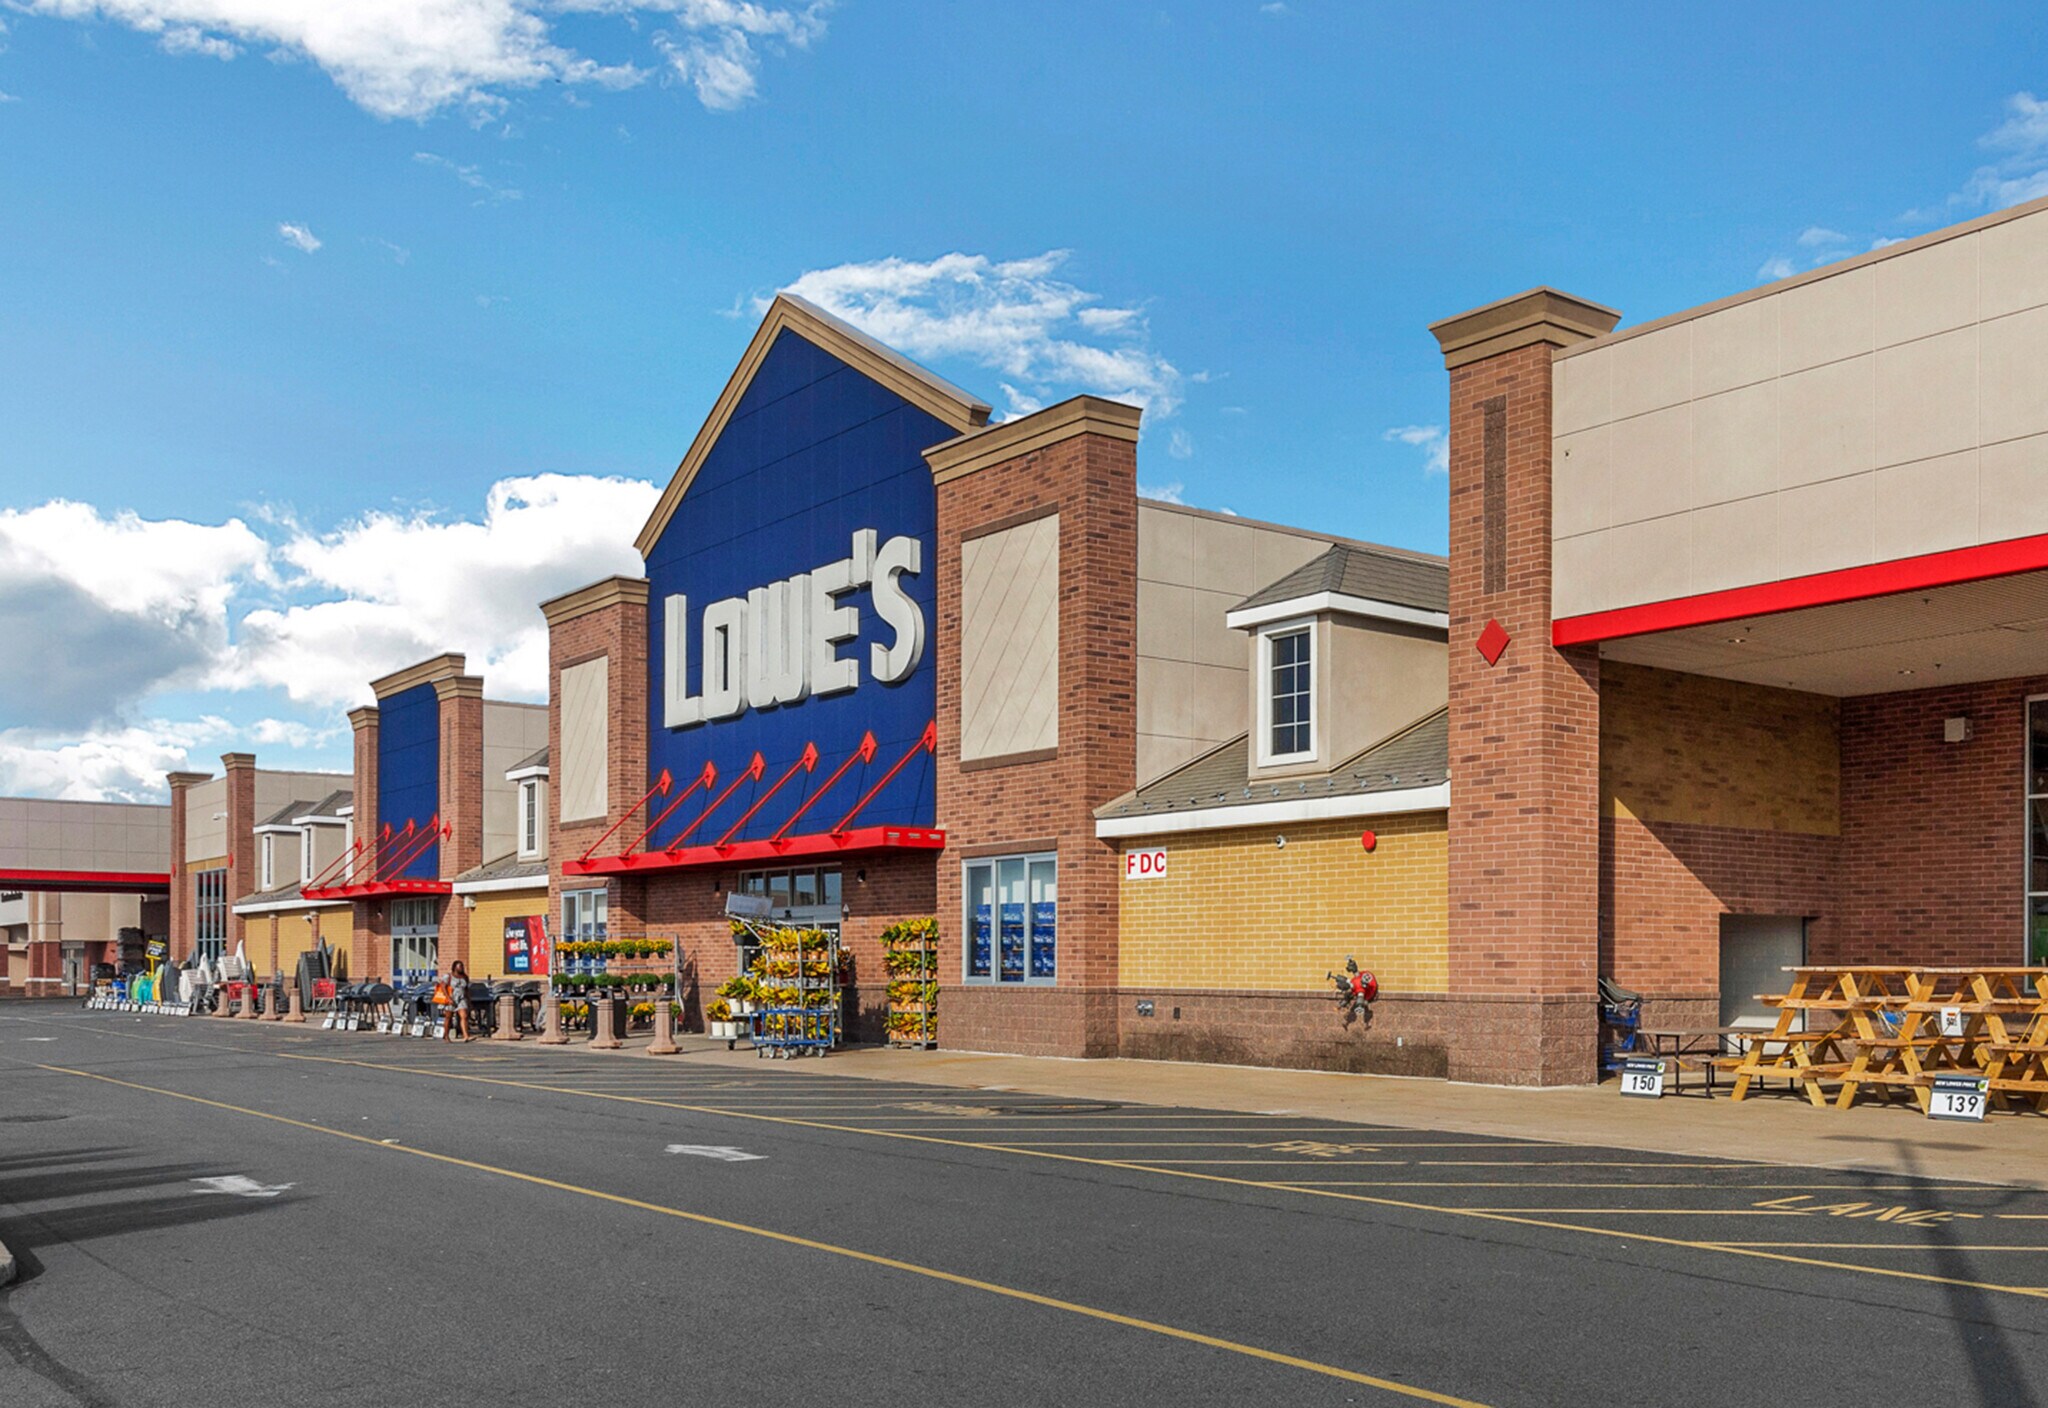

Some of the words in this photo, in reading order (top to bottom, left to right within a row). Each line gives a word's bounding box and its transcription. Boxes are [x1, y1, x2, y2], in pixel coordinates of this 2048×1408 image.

[664, 528, 925, 728] LOWE'S
[1127, 851, 1165, 875] FDC
[1632, 1075, 1655, 1091] 150
[1946, 1094, 1979, 1113] 139
[1751, 1194, 1984, 1227] LANE
